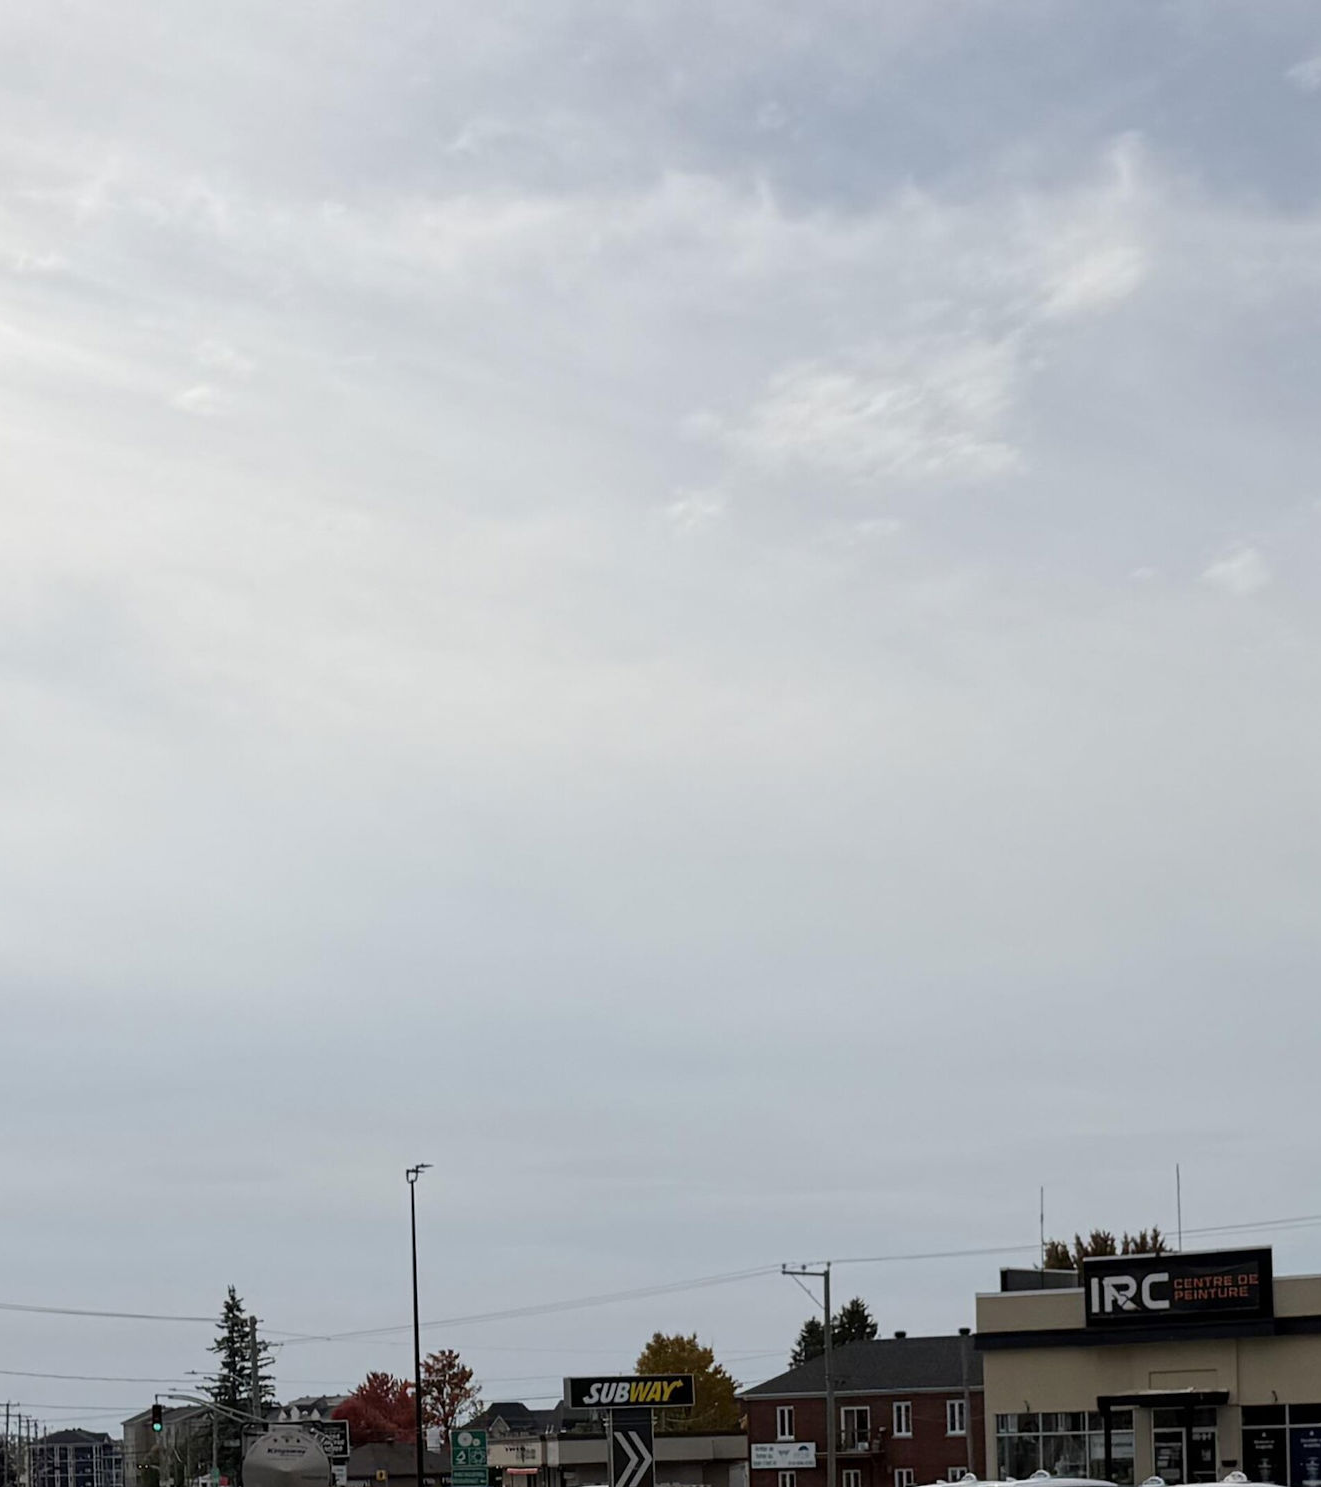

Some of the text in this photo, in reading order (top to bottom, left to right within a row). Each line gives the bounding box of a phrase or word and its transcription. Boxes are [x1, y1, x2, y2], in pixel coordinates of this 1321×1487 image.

[1091, 1272, 1259, 1313] IRC CENTRE DE
[1174, 1287, 1249, 1301] PEINTURE
[582, 1380, 684, 1405] SUBWAY
